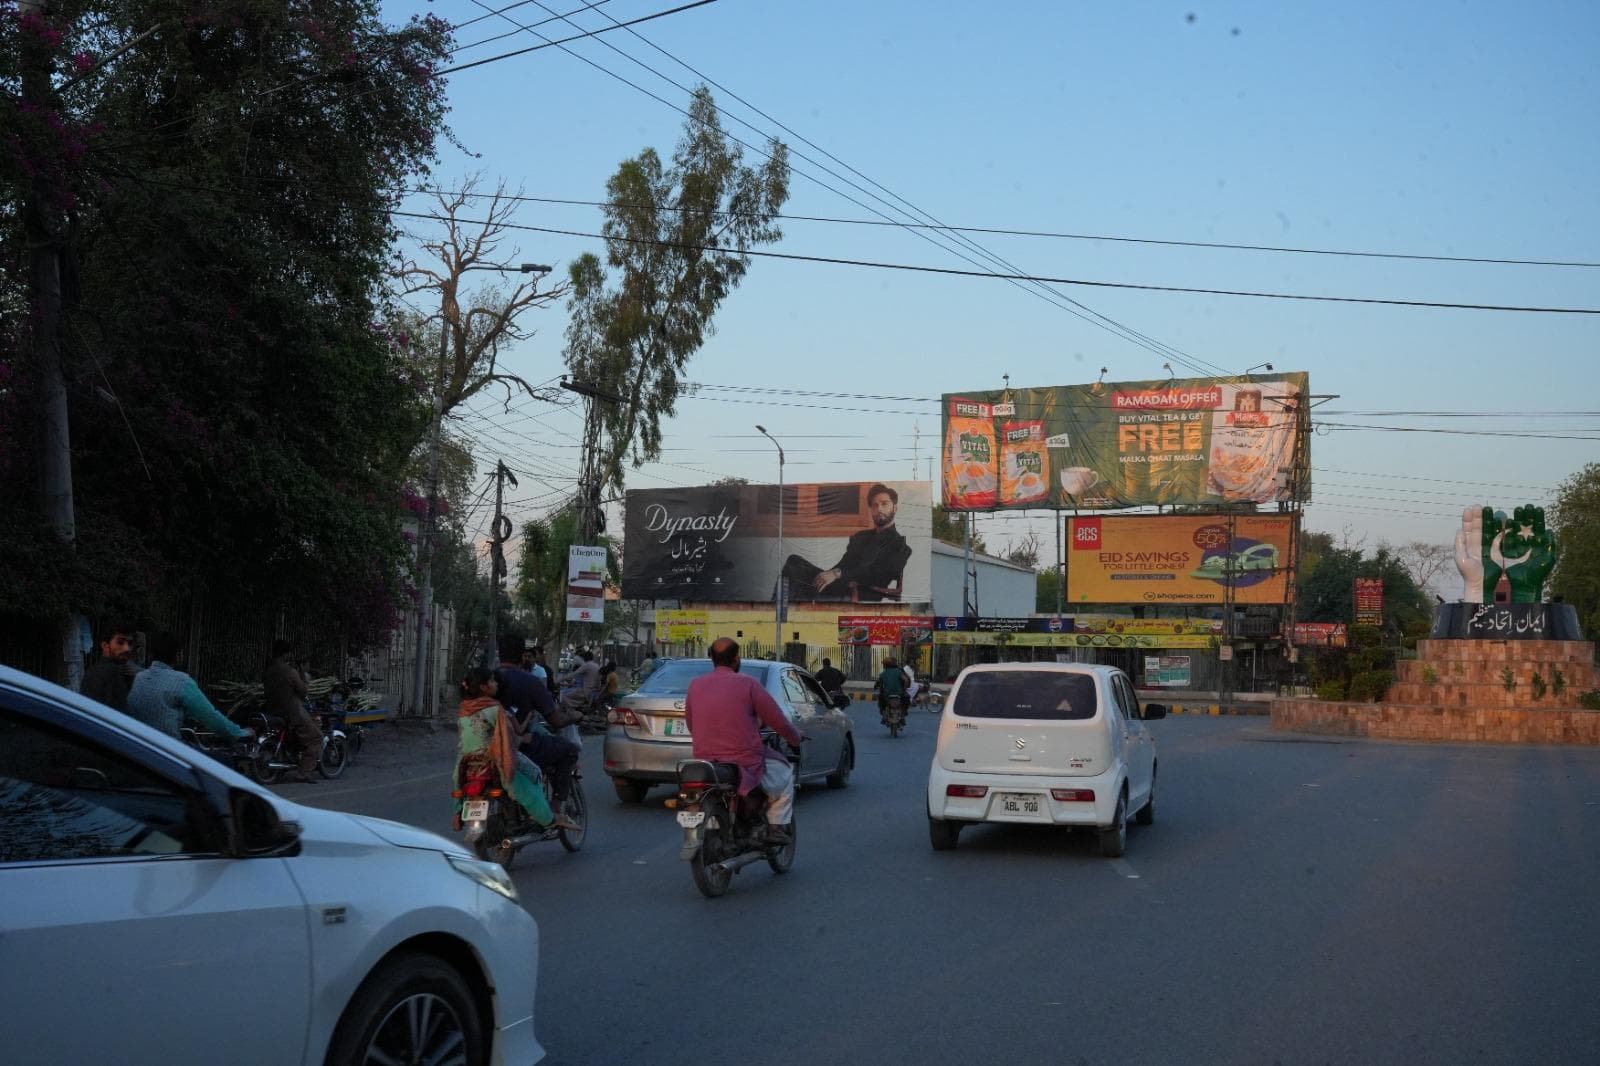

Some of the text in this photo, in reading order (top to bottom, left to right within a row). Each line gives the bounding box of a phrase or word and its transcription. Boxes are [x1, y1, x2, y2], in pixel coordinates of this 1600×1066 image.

[1117, 392, 1217, 406] RAMADAN OFFER
[957, 403, 979, 415] FREE
[1119, 415, 1136, 423] BUY
[1138, 414, 1160, 422] VITAL
[1163, 413, 1179, 421] TEA
[1007, 428, 1030, 441] FREE
[1119, 422, 1203, 452] FREE
[961, 440, 988, 452] VITAL
[1019, 458, 1040, 466] VITAL
[645, 504, 738, 543] Dynasty
[1099, 552, 1190, 563] EID SAVINGS
[1004, 801, 1020, 812] ABL
